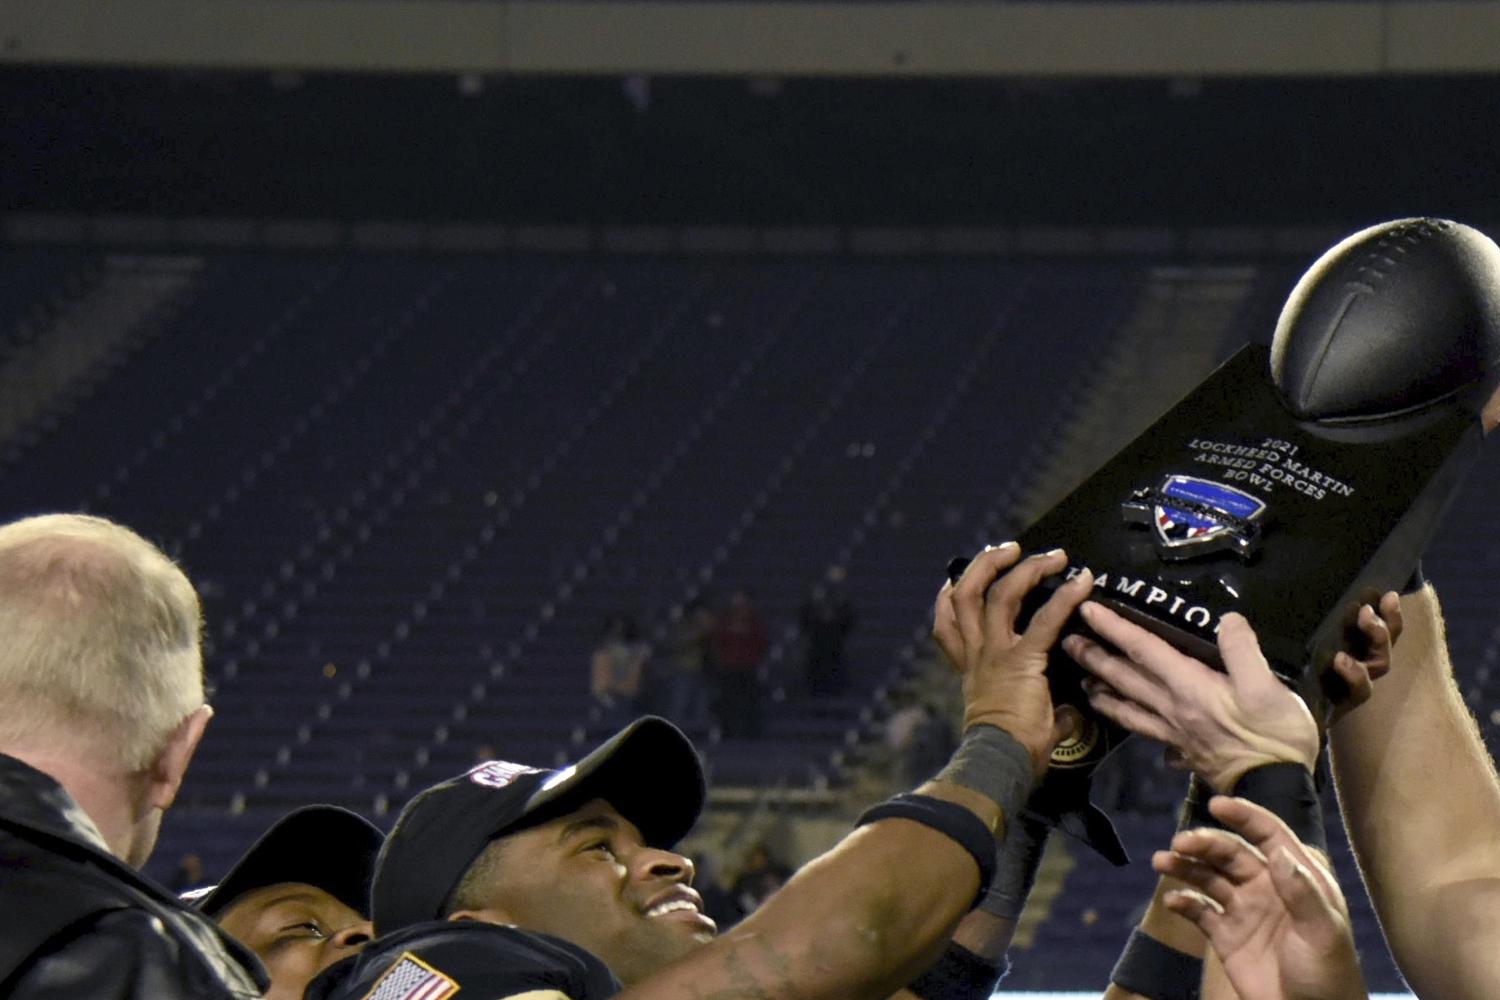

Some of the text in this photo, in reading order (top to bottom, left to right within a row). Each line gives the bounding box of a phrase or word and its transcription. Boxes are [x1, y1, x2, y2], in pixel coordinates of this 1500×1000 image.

[1262, 438, 1299, 456] 2021
[1188, 439, 1355, 497] LOCKHEED MARTIN
[1194, 453, 1257, 470] ARMED
[1258, 463, 1327, 500] FORCES
[1223, 469, 1275, 492] BOWL
